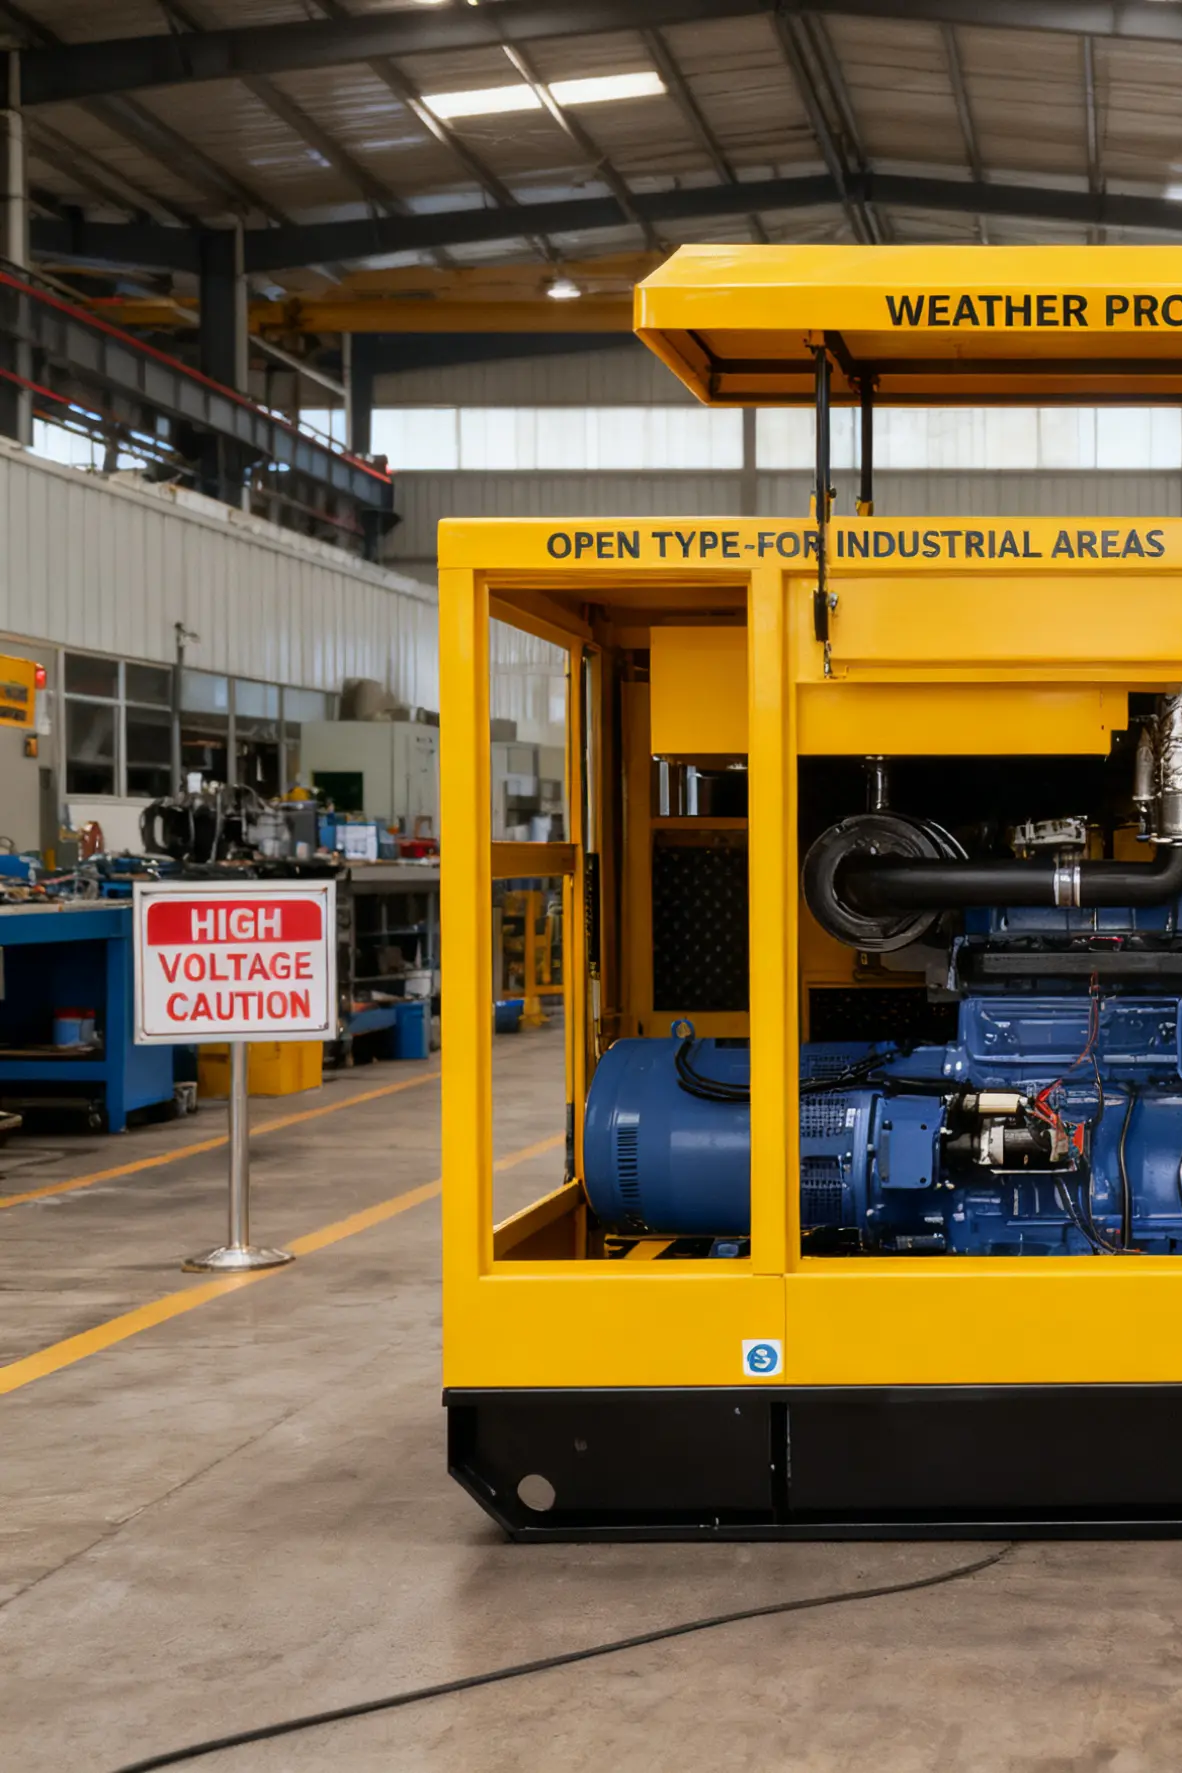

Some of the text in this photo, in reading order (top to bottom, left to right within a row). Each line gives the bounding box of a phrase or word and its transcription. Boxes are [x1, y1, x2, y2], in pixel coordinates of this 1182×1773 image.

[885, 294, 1088, 327] WEATHER
[547, 530, 640, 559] OPEN
[837, 529, 1043, 559] INDUSTRIAL
[1051, 529, 1165, 559] AREAS
[191, 907, 282, 942] HIGH
[157, 951, 314, 984] VOLTAGE
[166, 988, 311, 1022] CAUTION
